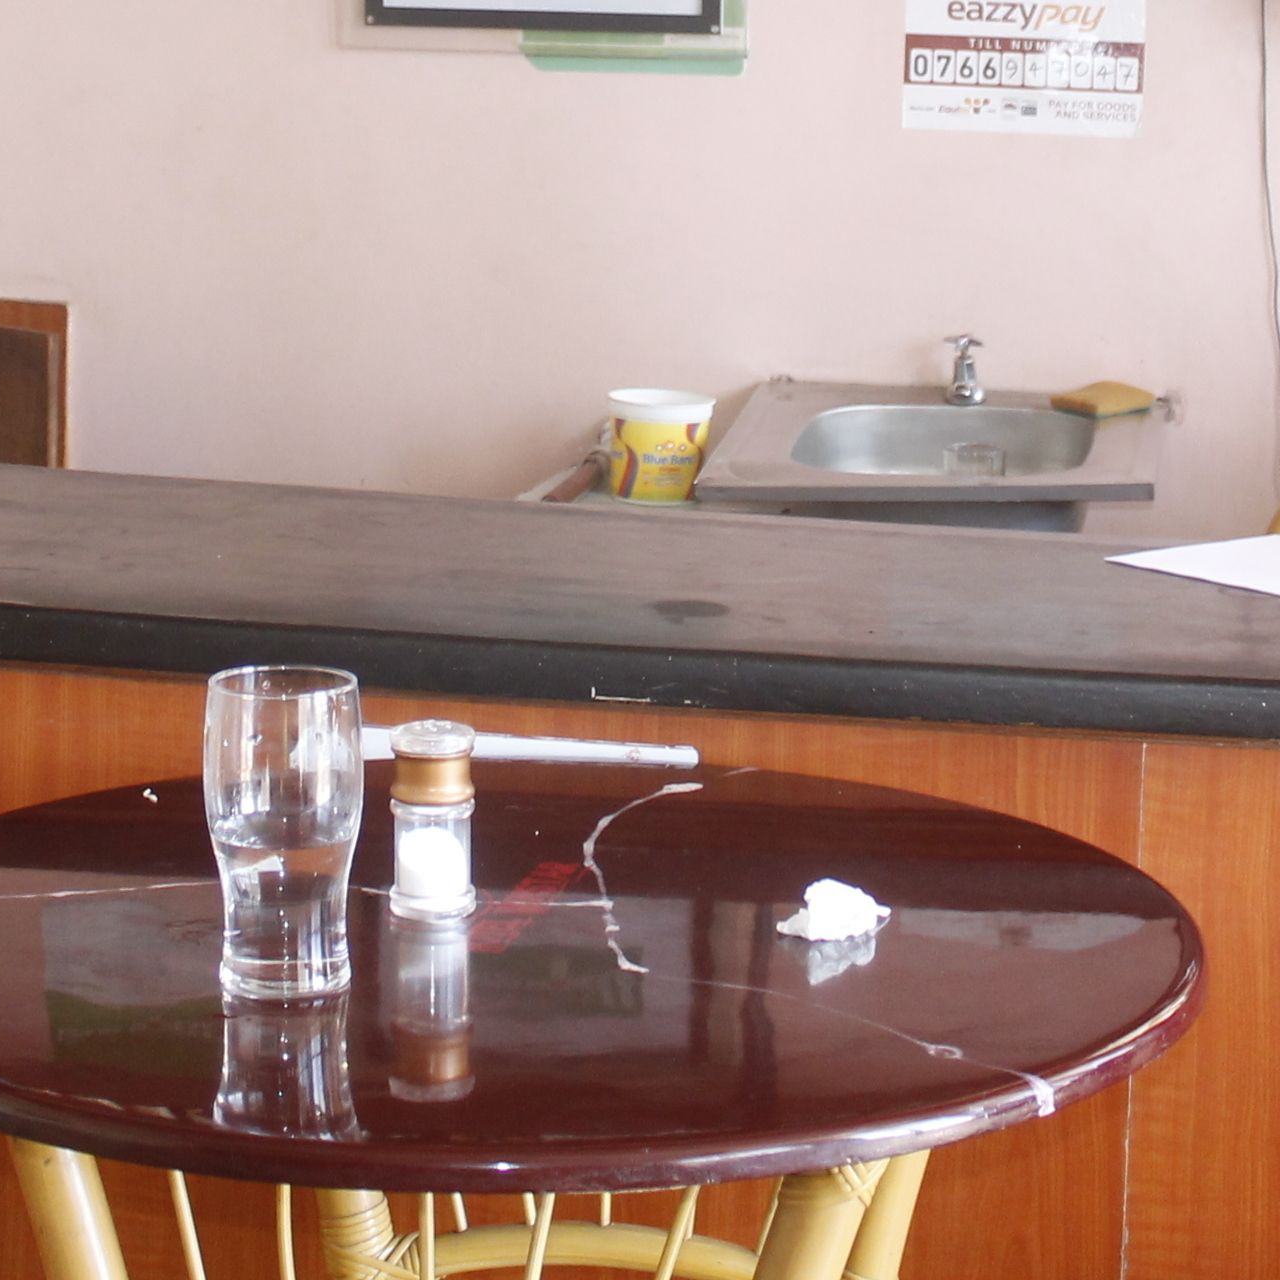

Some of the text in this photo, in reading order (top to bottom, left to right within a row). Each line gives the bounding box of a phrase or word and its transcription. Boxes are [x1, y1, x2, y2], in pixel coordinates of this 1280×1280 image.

[968, 38, 1003, 50] TILL
[1048, 99, 1137, 113] PAY FOR GOODS
[1055, 110, 1137, 123] AND SERVICES
[643, 453, 668, 465] Blue
